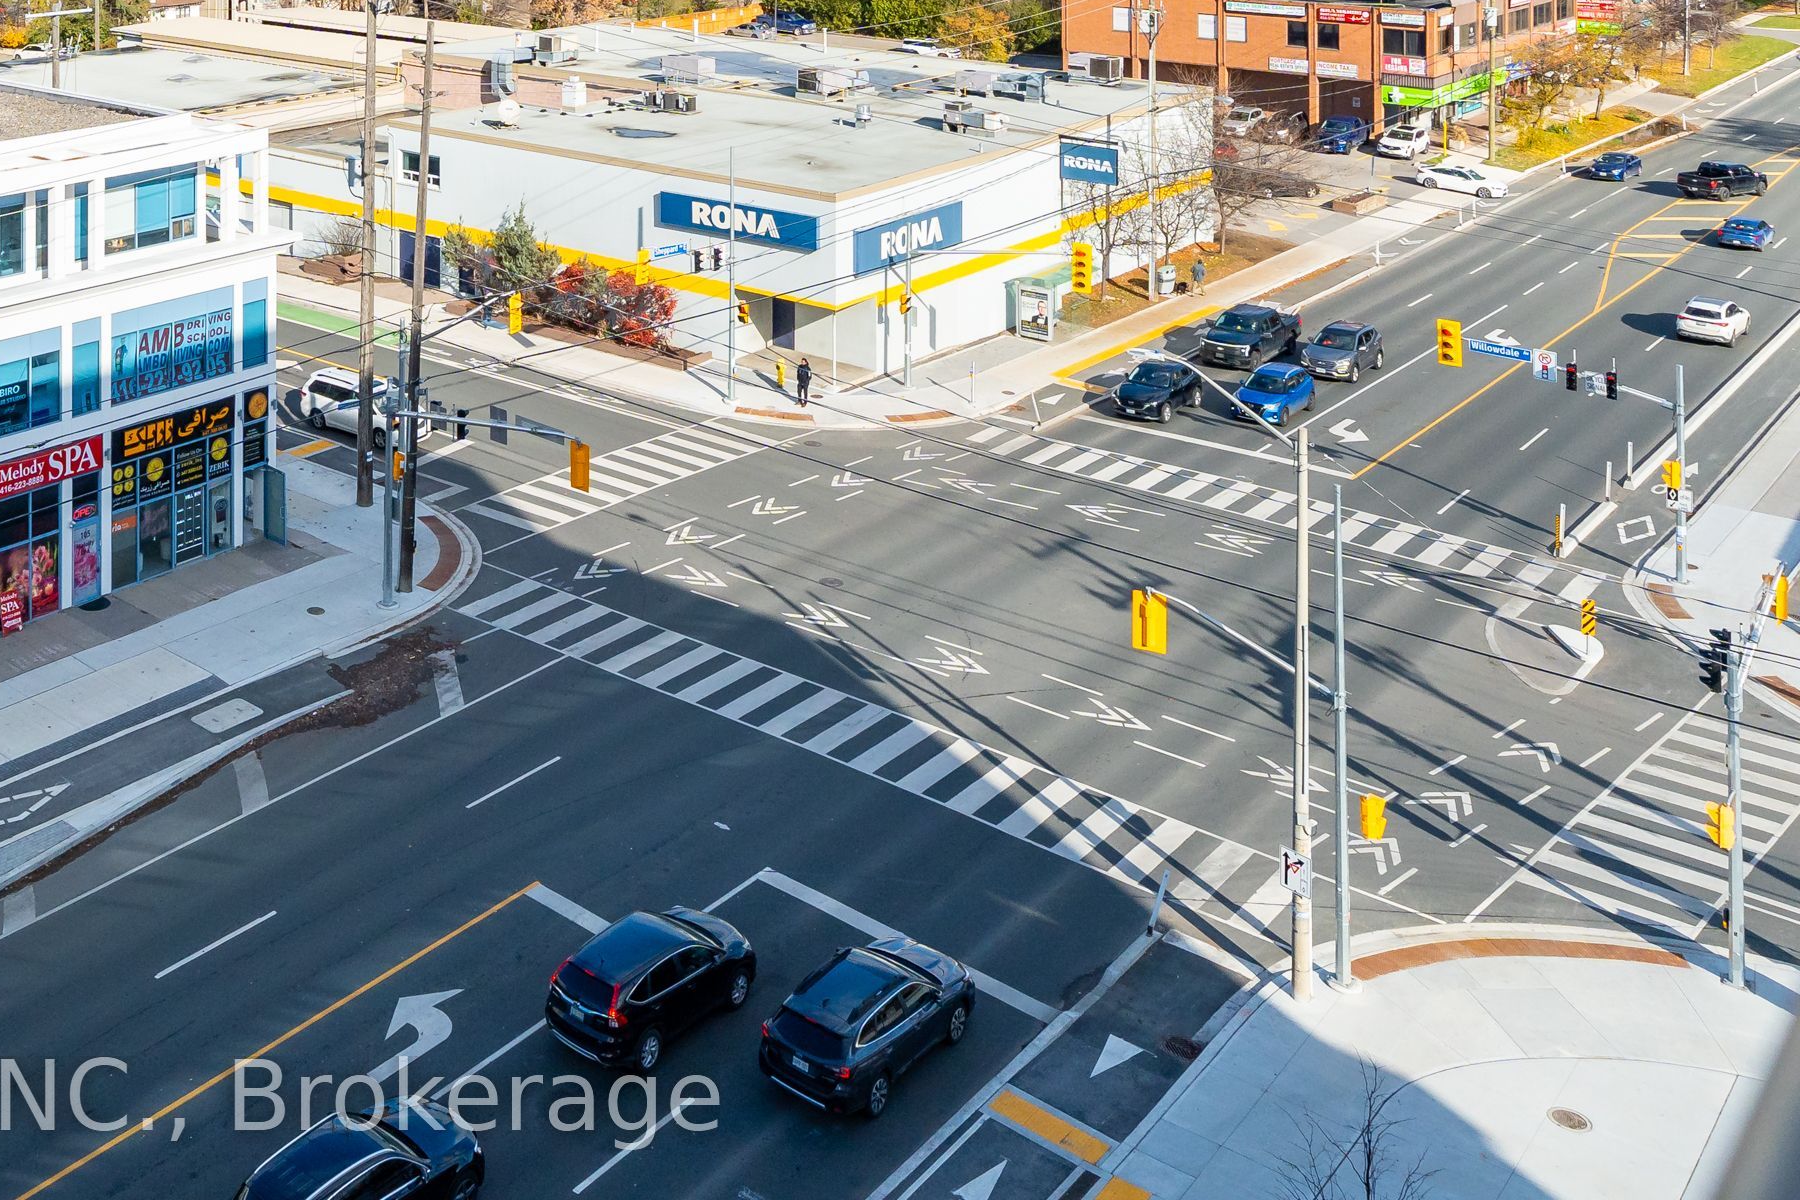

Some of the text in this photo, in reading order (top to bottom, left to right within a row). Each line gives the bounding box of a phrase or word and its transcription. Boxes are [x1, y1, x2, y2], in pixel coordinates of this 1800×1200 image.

[1064, 154, 1114, 174] RONA
[691, 201, 780, 239] RONA
[880, 216, 943, 260] RONA
[187, 311, 231, 330] DRIVING
[138, 322, 185, 355] AMB
[1471, 340, 1520, 358] Willowdale
[0, 385, 20, 398] BIRO
[0, 441, 98, 484] Melody SPA
[209, 460, 230, 473] ZERIK
[0, 474, 45, 495] 416-223-8889
[73, 504, 96, 520] OPEN
[0, 600, 20, 615] SPA
